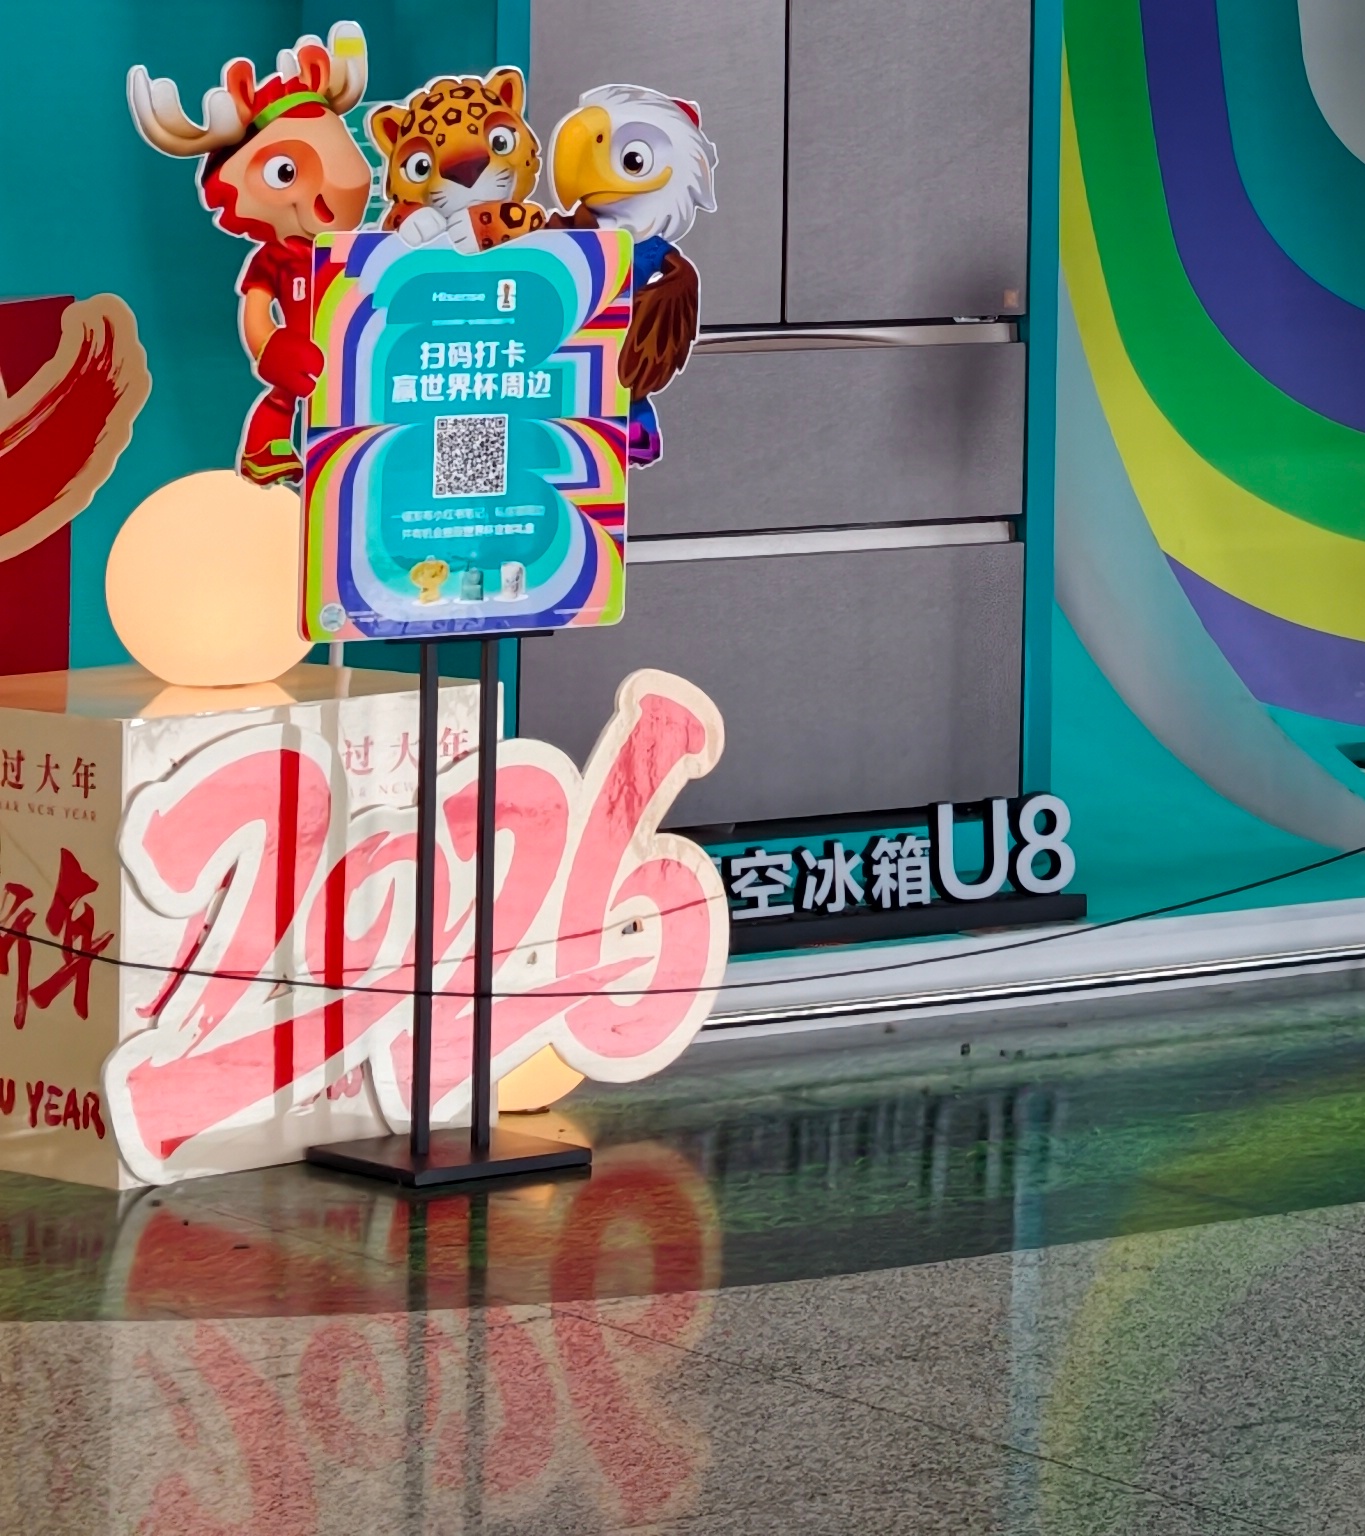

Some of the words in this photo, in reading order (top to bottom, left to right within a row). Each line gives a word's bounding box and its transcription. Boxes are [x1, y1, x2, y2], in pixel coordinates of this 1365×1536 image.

[419, 340, 528, 370] 扫码打卡
[391, 370, 552, 404] 赢世界杯周边
[1, 749, 97, 799] 过大年
[713, 795, 1076, 920] 空冰箱U8
[127, 693, 708, 1161] 2026
[26, 1080, 106, 1140] YEAR
